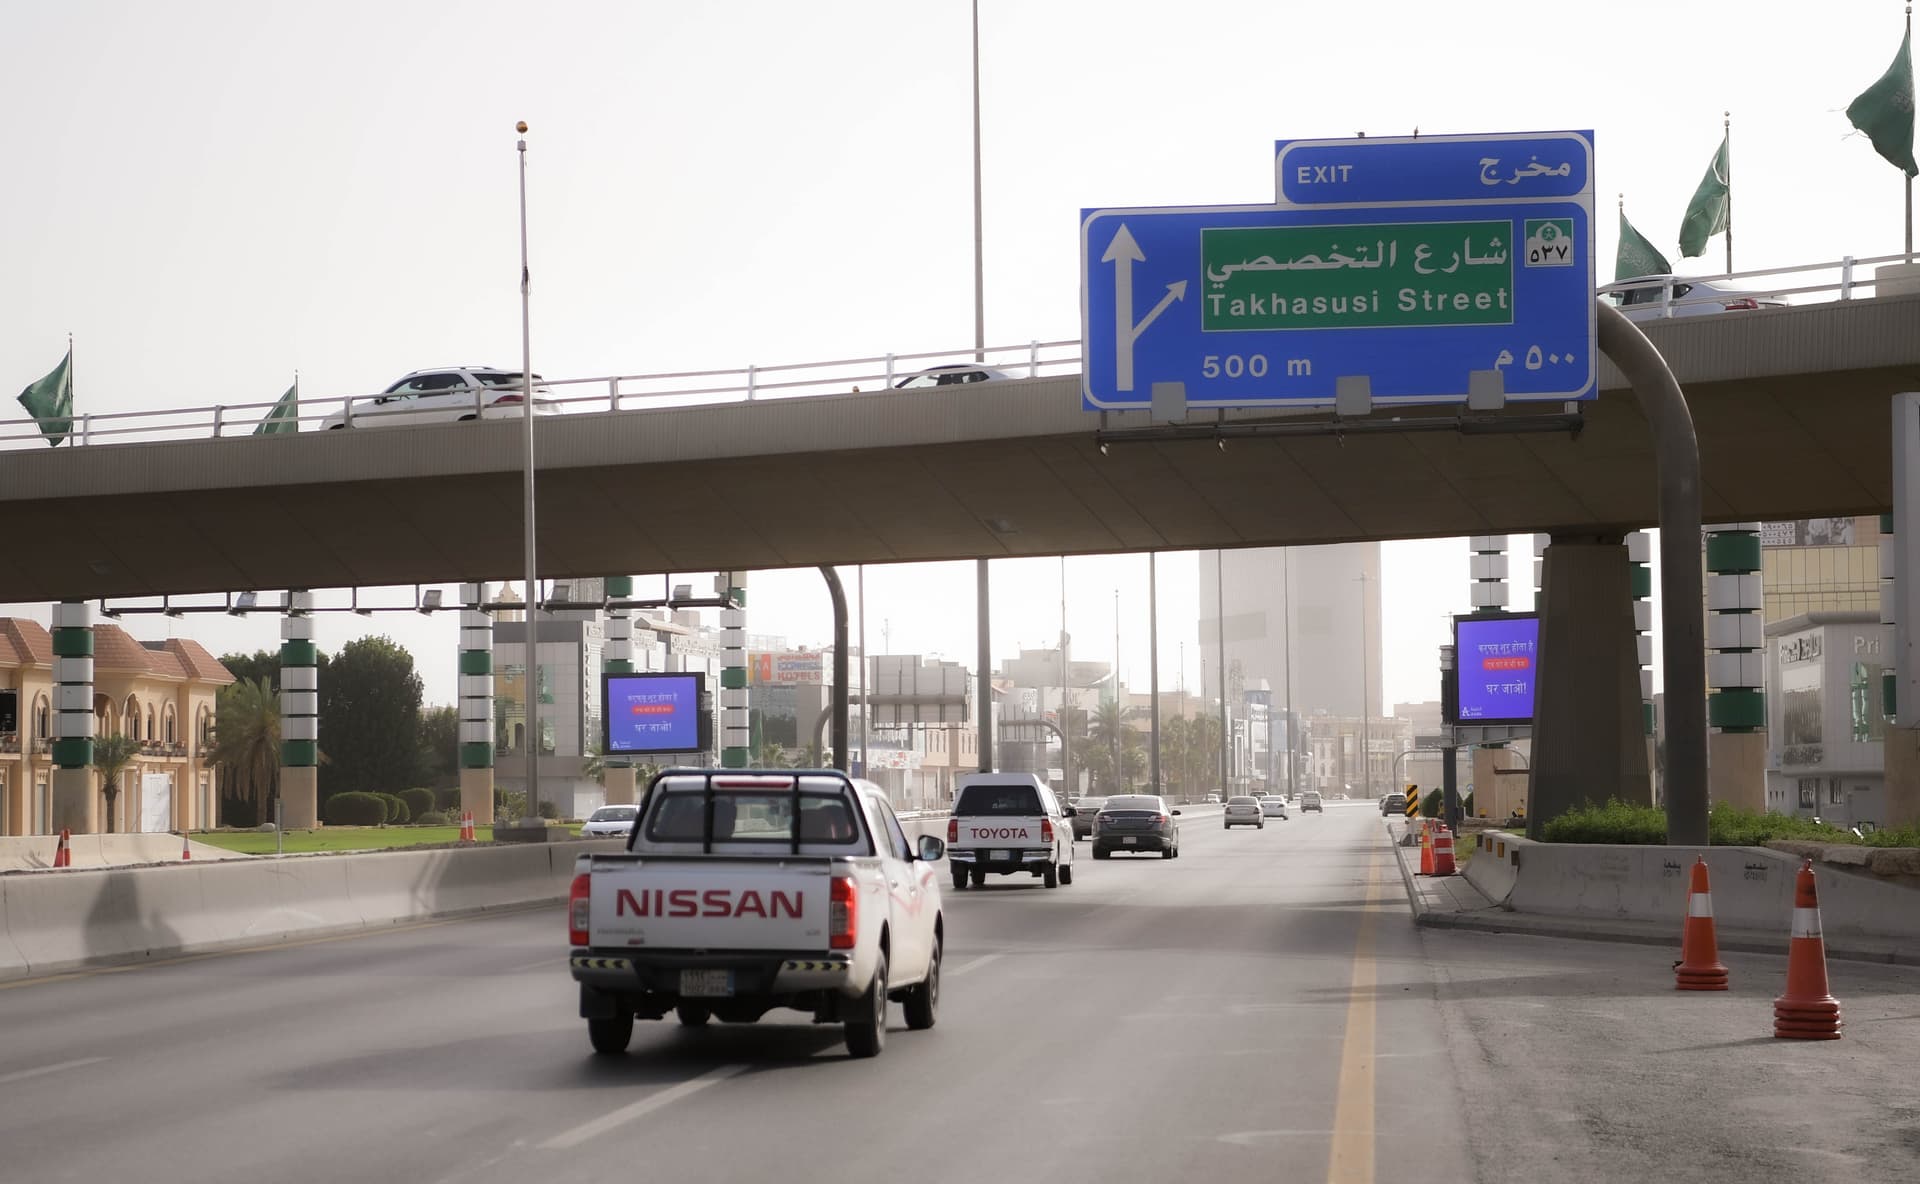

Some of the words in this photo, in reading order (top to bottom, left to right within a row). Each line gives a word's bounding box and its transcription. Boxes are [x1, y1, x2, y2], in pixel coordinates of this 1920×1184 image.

[1297, 165, 1352, 184] EXIT
[1478, 157, 1572, 185] مخرج
[1206, 240, 1397, 289] التخصصي
[1413, 237, 1508, 274] شارع
[1530, 245, 1568, 263] ٥٣٧
[1208, 290, 1379, 316] Takhasusi
[1398, 287, 1509, 313] Street
[1203, 354, 1268, 379] 500
[1287, 358, 1312, 376] m
[1525, 345, 1574, 370] ٥٠٠
[970, 828, 1029, 839] TOYOTA
[616, 888, 803, 918] NISSAN
